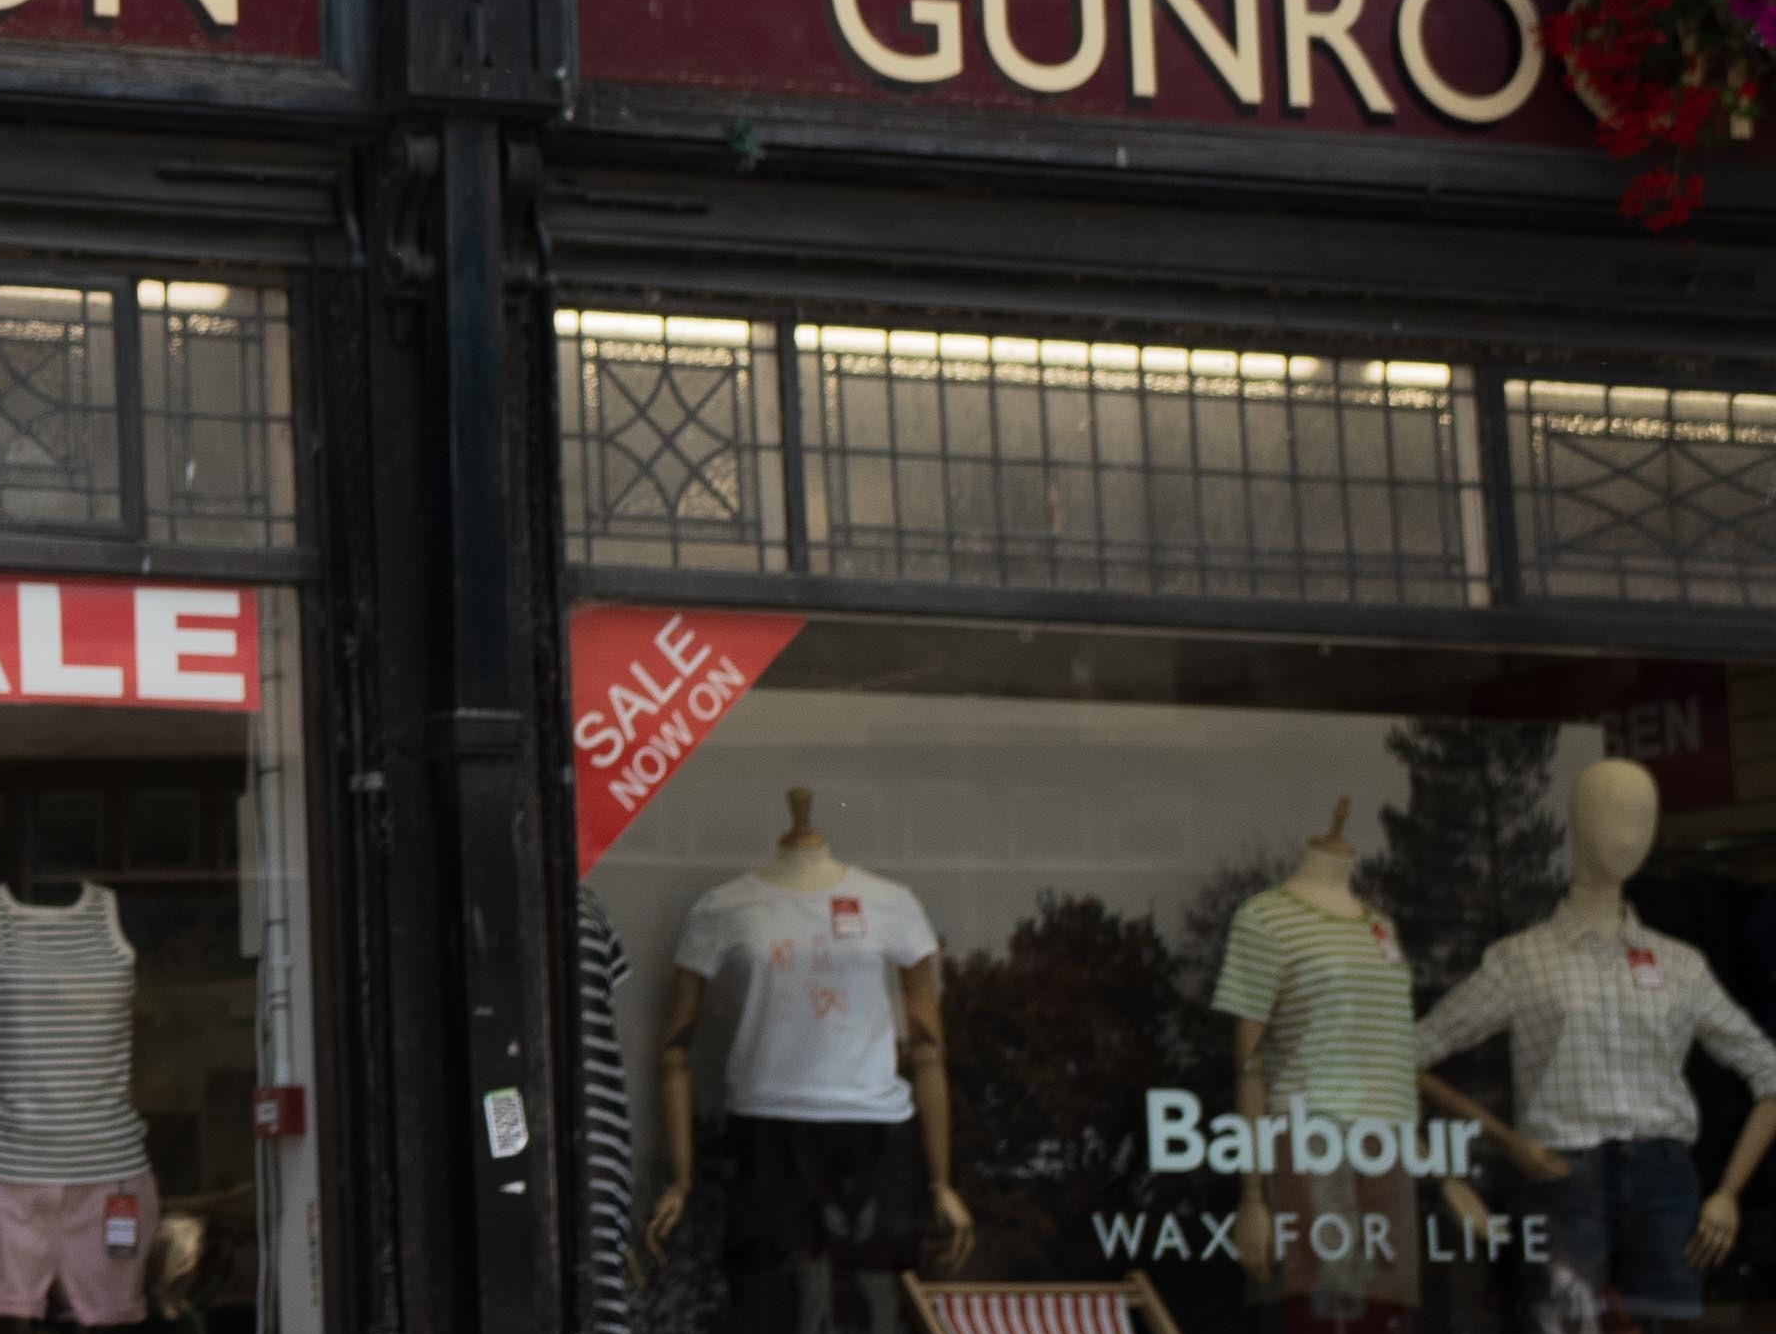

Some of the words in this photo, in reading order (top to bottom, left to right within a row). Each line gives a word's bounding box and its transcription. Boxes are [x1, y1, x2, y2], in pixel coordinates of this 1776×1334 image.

[573, 613, 712, 768] SALE
[608, 709, 694, 812] NOW
[688, 656, 746, 721] ON
[1146, 1087, 1482, 1177] Barbour
[1091, 1212, 1241, 1261] WAX
[1272, 1212, 1394, 1262] FOR
[1427, 1213, 1550, 1262] LIFE
